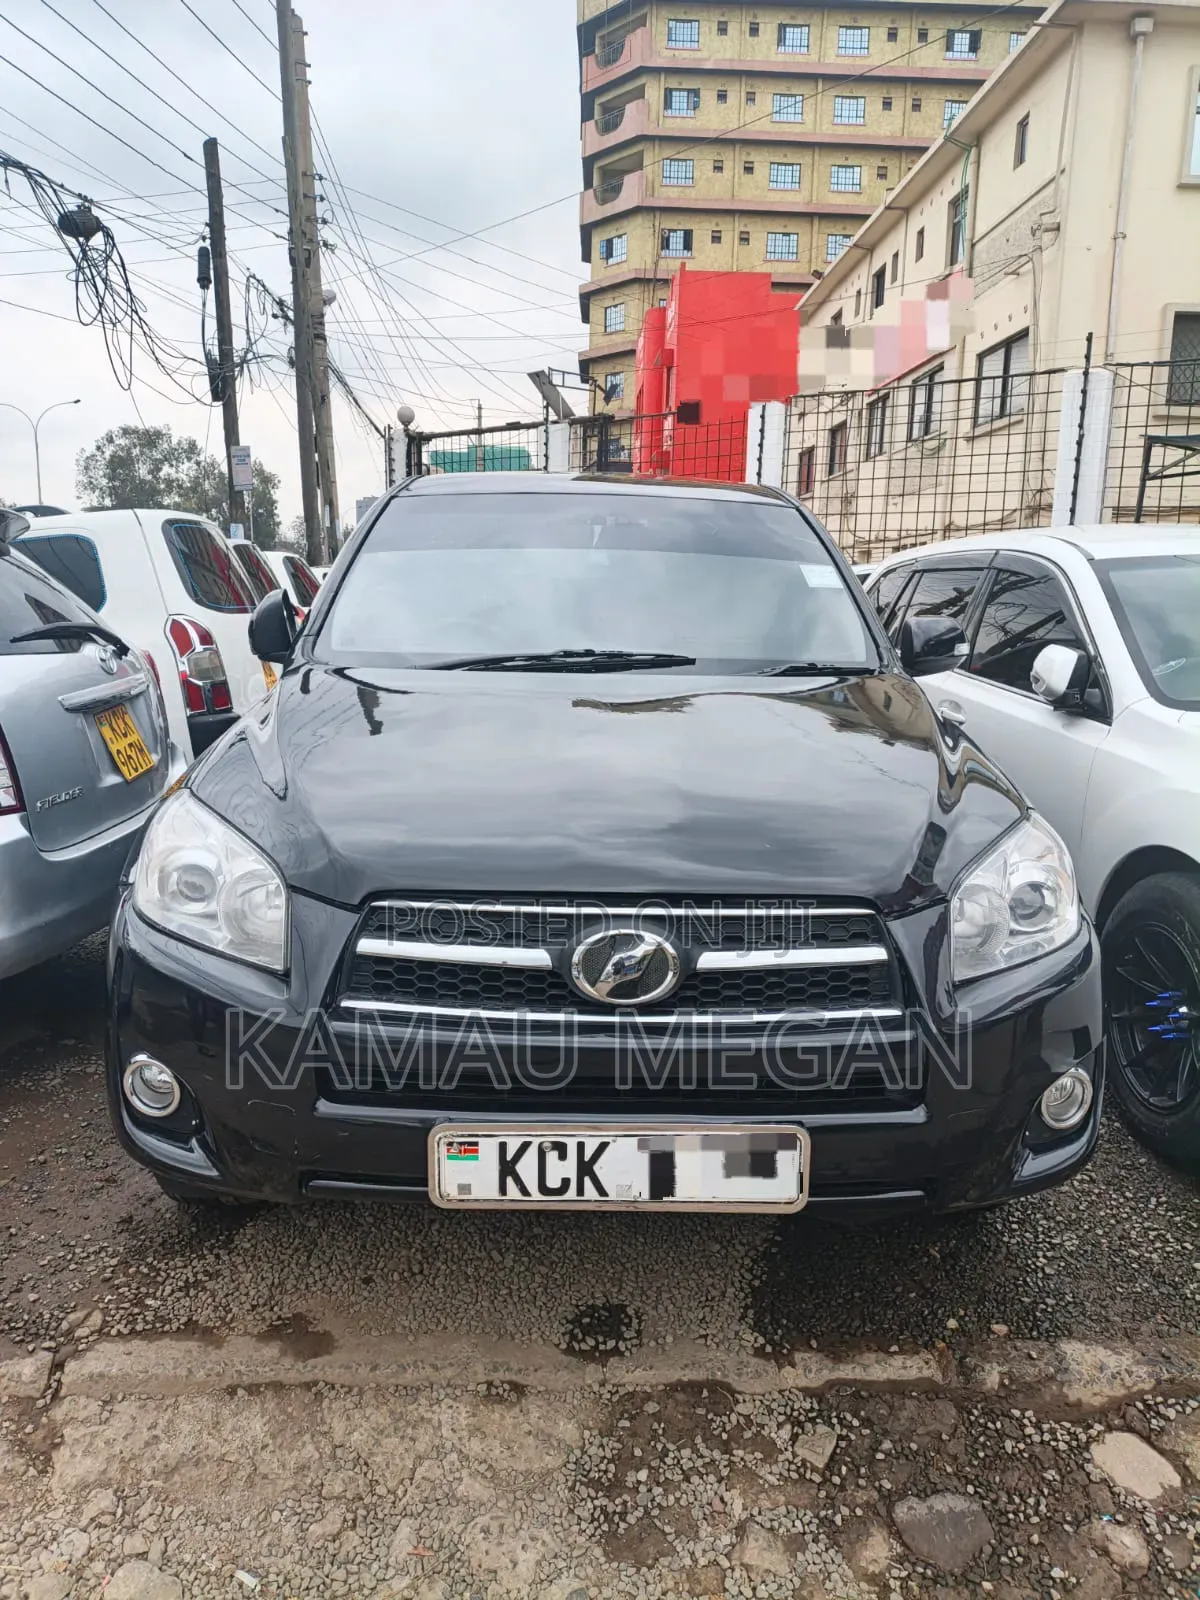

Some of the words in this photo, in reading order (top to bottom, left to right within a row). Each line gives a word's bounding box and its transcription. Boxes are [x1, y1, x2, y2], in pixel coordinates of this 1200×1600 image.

[104, 705, 136, 743] KCK
[36, 786, 84, 812] FIELDER
[499, 1140, 611, 1197] KCK
